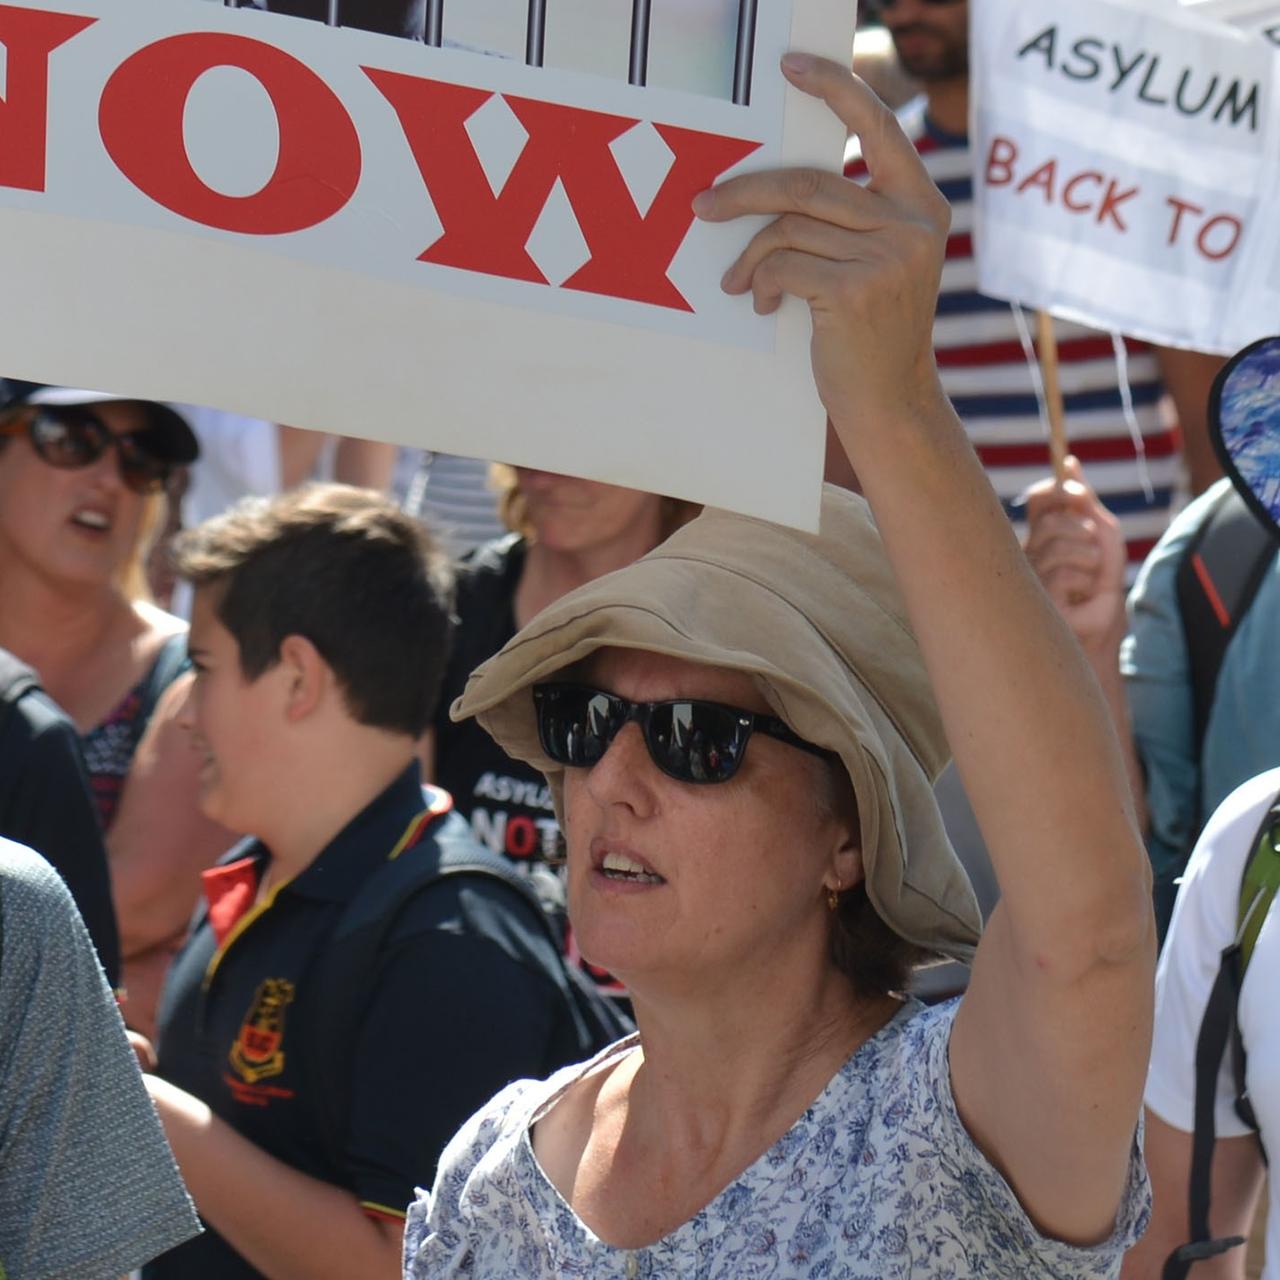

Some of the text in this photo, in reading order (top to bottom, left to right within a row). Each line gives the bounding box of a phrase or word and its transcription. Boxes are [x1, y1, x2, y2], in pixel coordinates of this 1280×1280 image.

[1017, 25, 1261, 133] ASYLUM
[983, 136, 1140, 234] BACK
[1165, 197, 1244, 262] TO
[471, 806, 560, 859] NOT
